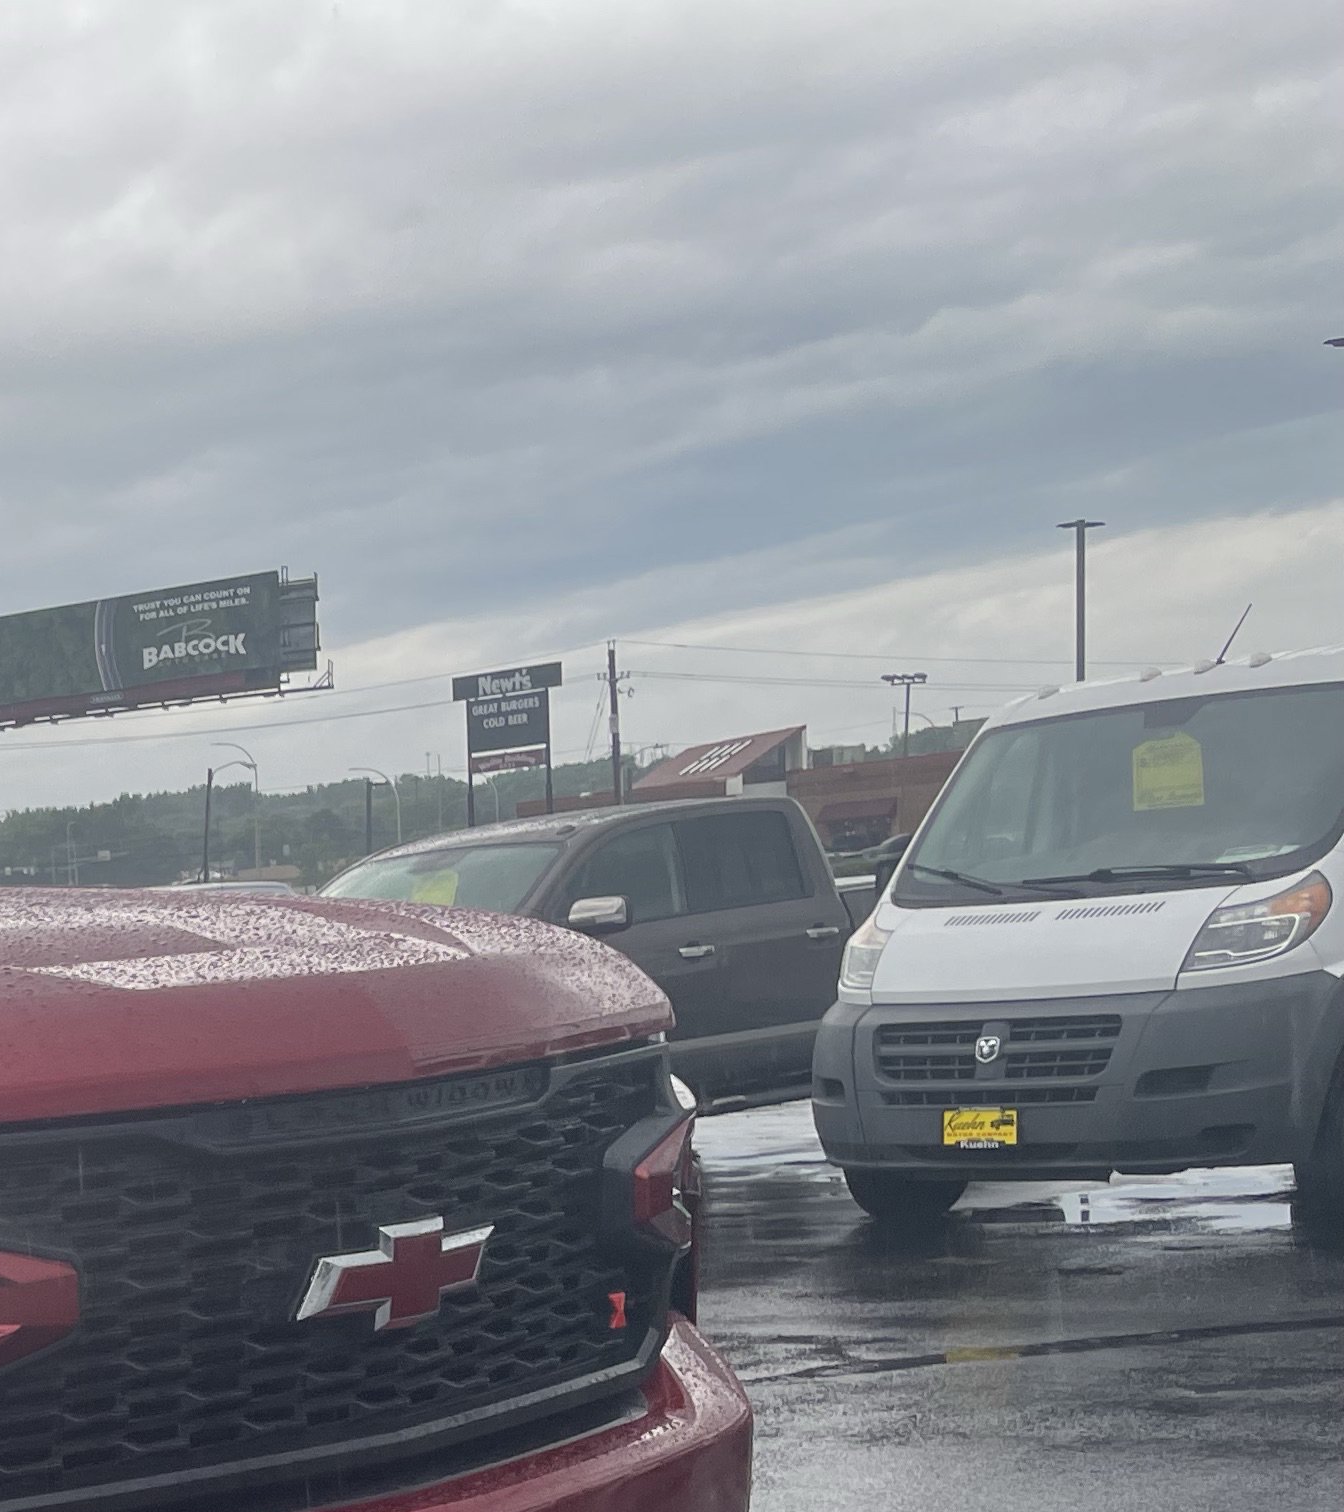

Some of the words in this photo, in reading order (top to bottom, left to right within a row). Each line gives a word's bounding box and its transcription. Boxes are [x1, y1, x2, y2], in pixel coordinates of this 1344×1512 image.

[133, 600, 161, 613] TRUST
[163, 597, 181, 607] YOU
[182, 594, 202, 604] CAN
[203, 588, 235, 601] COUNT
[236, 586, 251, 596] ON
[139, 612, 157, 622] FOR
[158, 609, 175, 618] ALL
[177, 605, 189, 615] OF
[190, 601, 218, 613] LIFE'S
[142, 632, 247, 670] BABCOCK
[478, 669, 532, 696] Newt's
[472, 702, 498, 716] GREAT
[500, 696, 540, 712] BURGERS
[483, 716, 505, 729] COLD
[507, 713, 528, 726] BEER
[959, 1139, 1000, 1150] Kuehn
